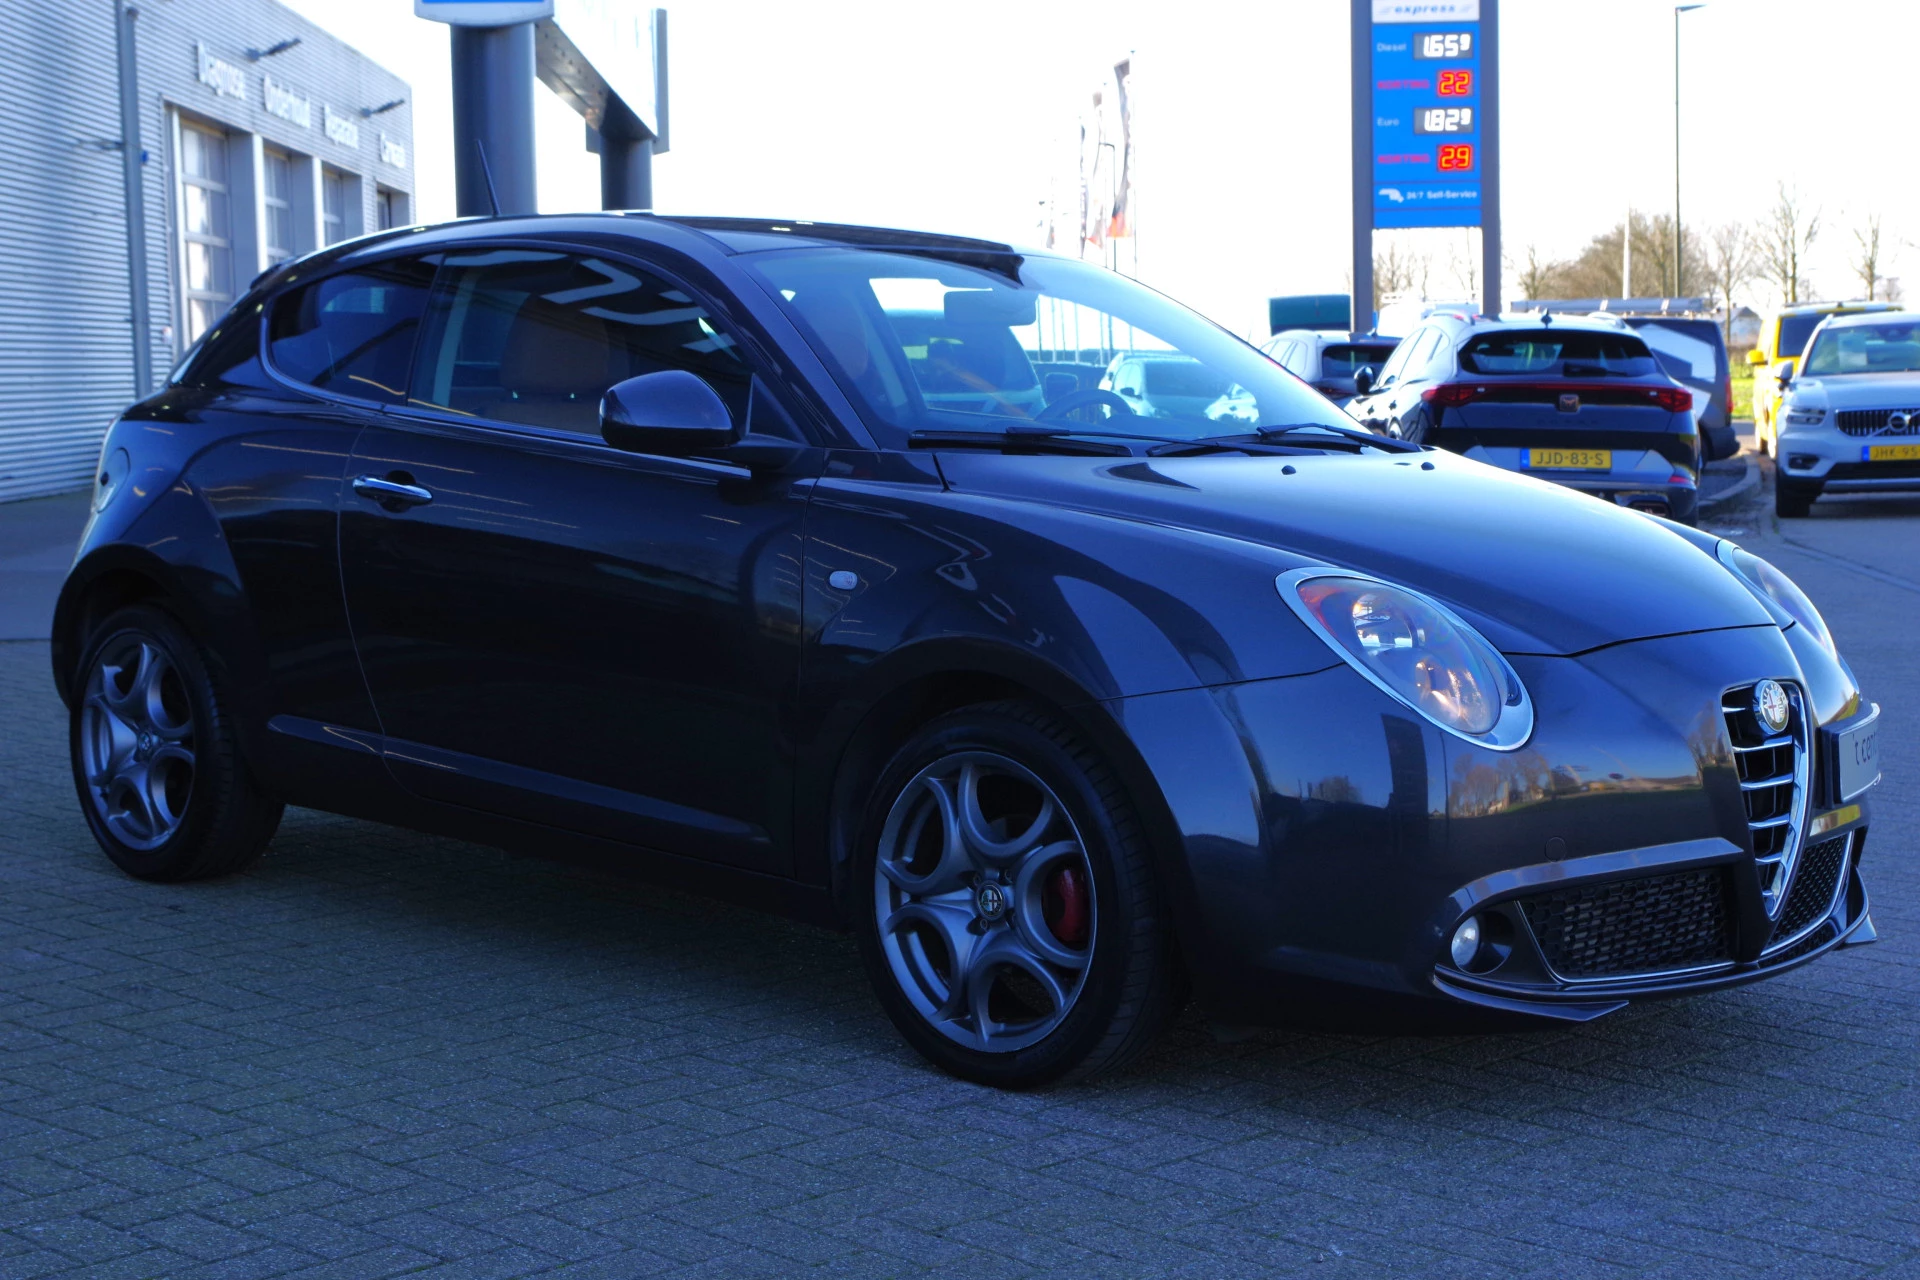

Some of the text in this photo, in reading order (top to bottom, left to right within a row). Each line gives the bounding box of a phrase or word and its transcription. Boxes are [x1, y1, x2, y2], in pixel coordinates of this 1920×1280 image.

[1394, 4, 1456, 15] express
[1376, 42, 1407, 52] Diesel
[197, 40, 246, 100] Diagnose
[1438, 70, 1471, 96] 22
[263, 73, 311, 129] Onderhoud
[1376, 117, 1399, 127] Euro
[1438, 145, 1471, 171] 29
[1426, 189, 1478, 200] Self-Service
[1535, 451, 1604, 466] JJD-83-S
